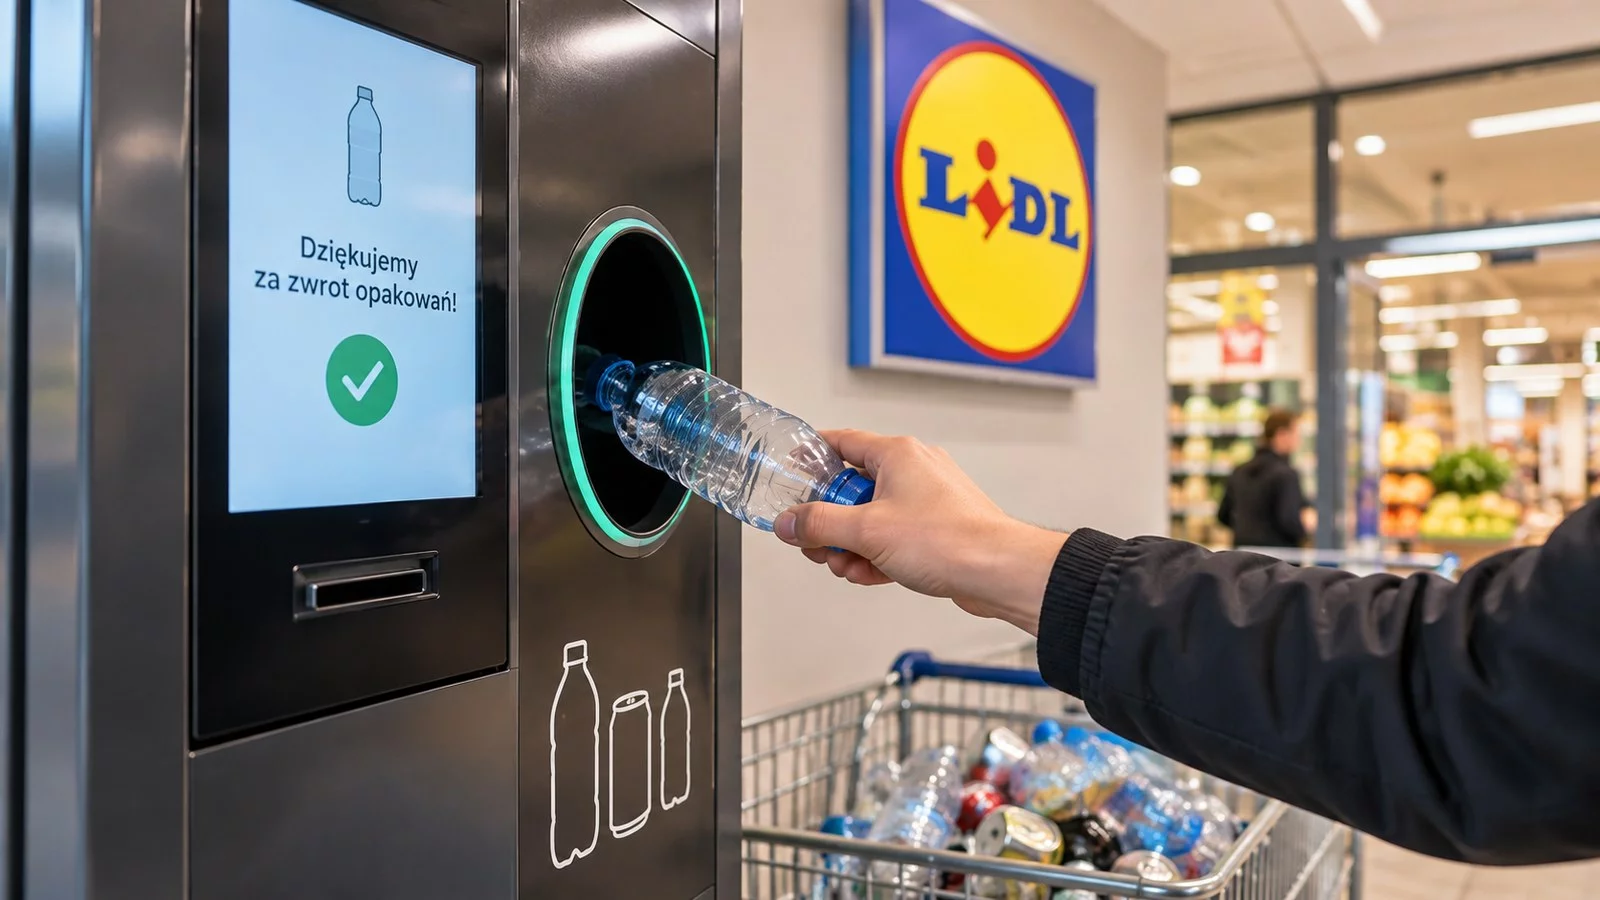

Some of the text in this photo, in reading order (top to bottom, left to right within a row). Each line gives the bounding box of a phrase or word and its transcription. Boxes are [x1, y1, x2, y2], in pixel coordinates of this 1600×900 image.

[301, 235, 418, 280] Dziękujemy
[254, 270, 457, 312] za zwrot opakowań!
